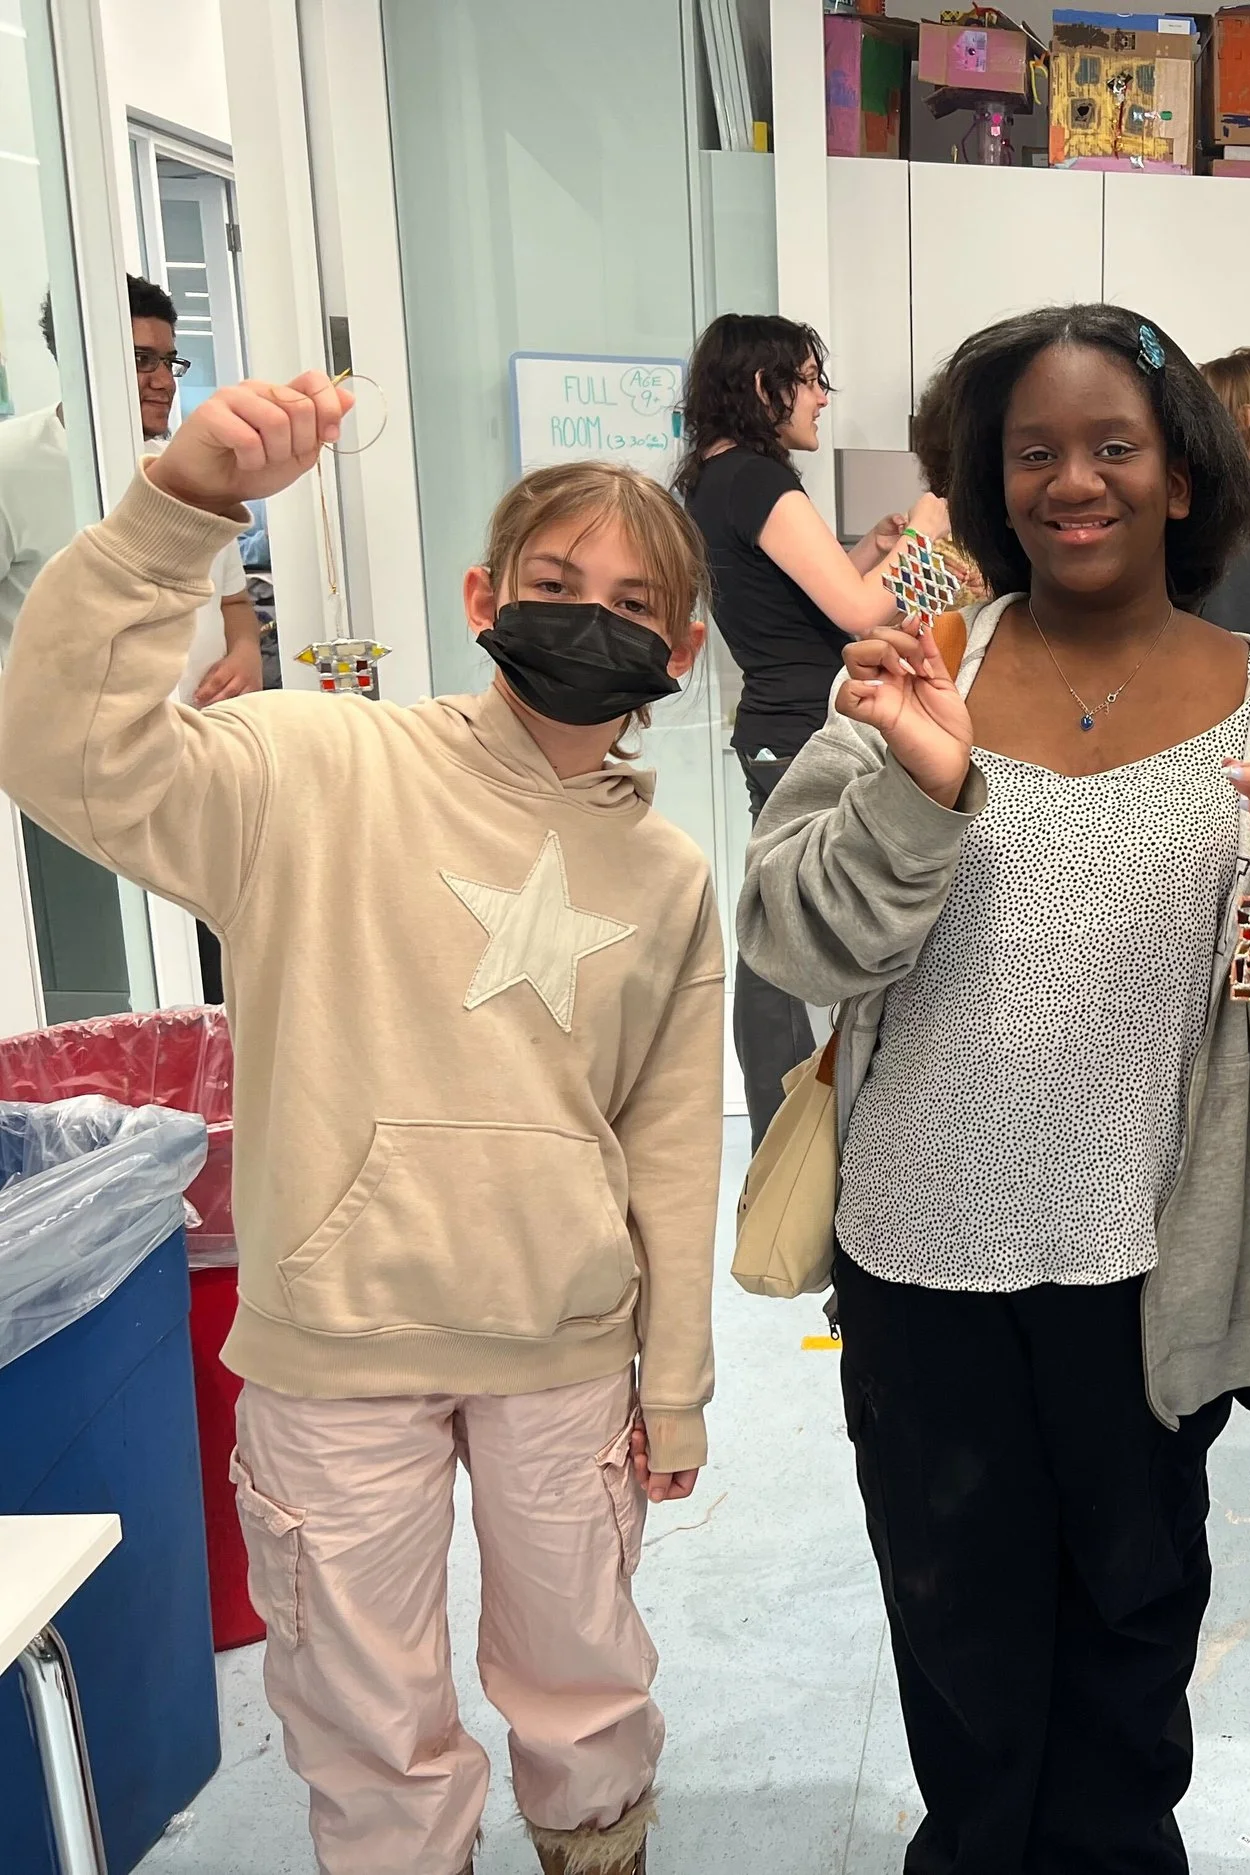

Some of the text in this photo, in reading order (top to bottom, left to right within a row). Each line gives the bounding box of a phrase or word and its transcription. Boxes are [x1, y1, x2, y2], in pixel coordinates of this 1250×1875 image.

[564, 375, 618, 405] FULL
[629, 370, 663, 387] AGE
[641, 390, 661, 408] 9+
[551, 415, 602, 450] ROOM
